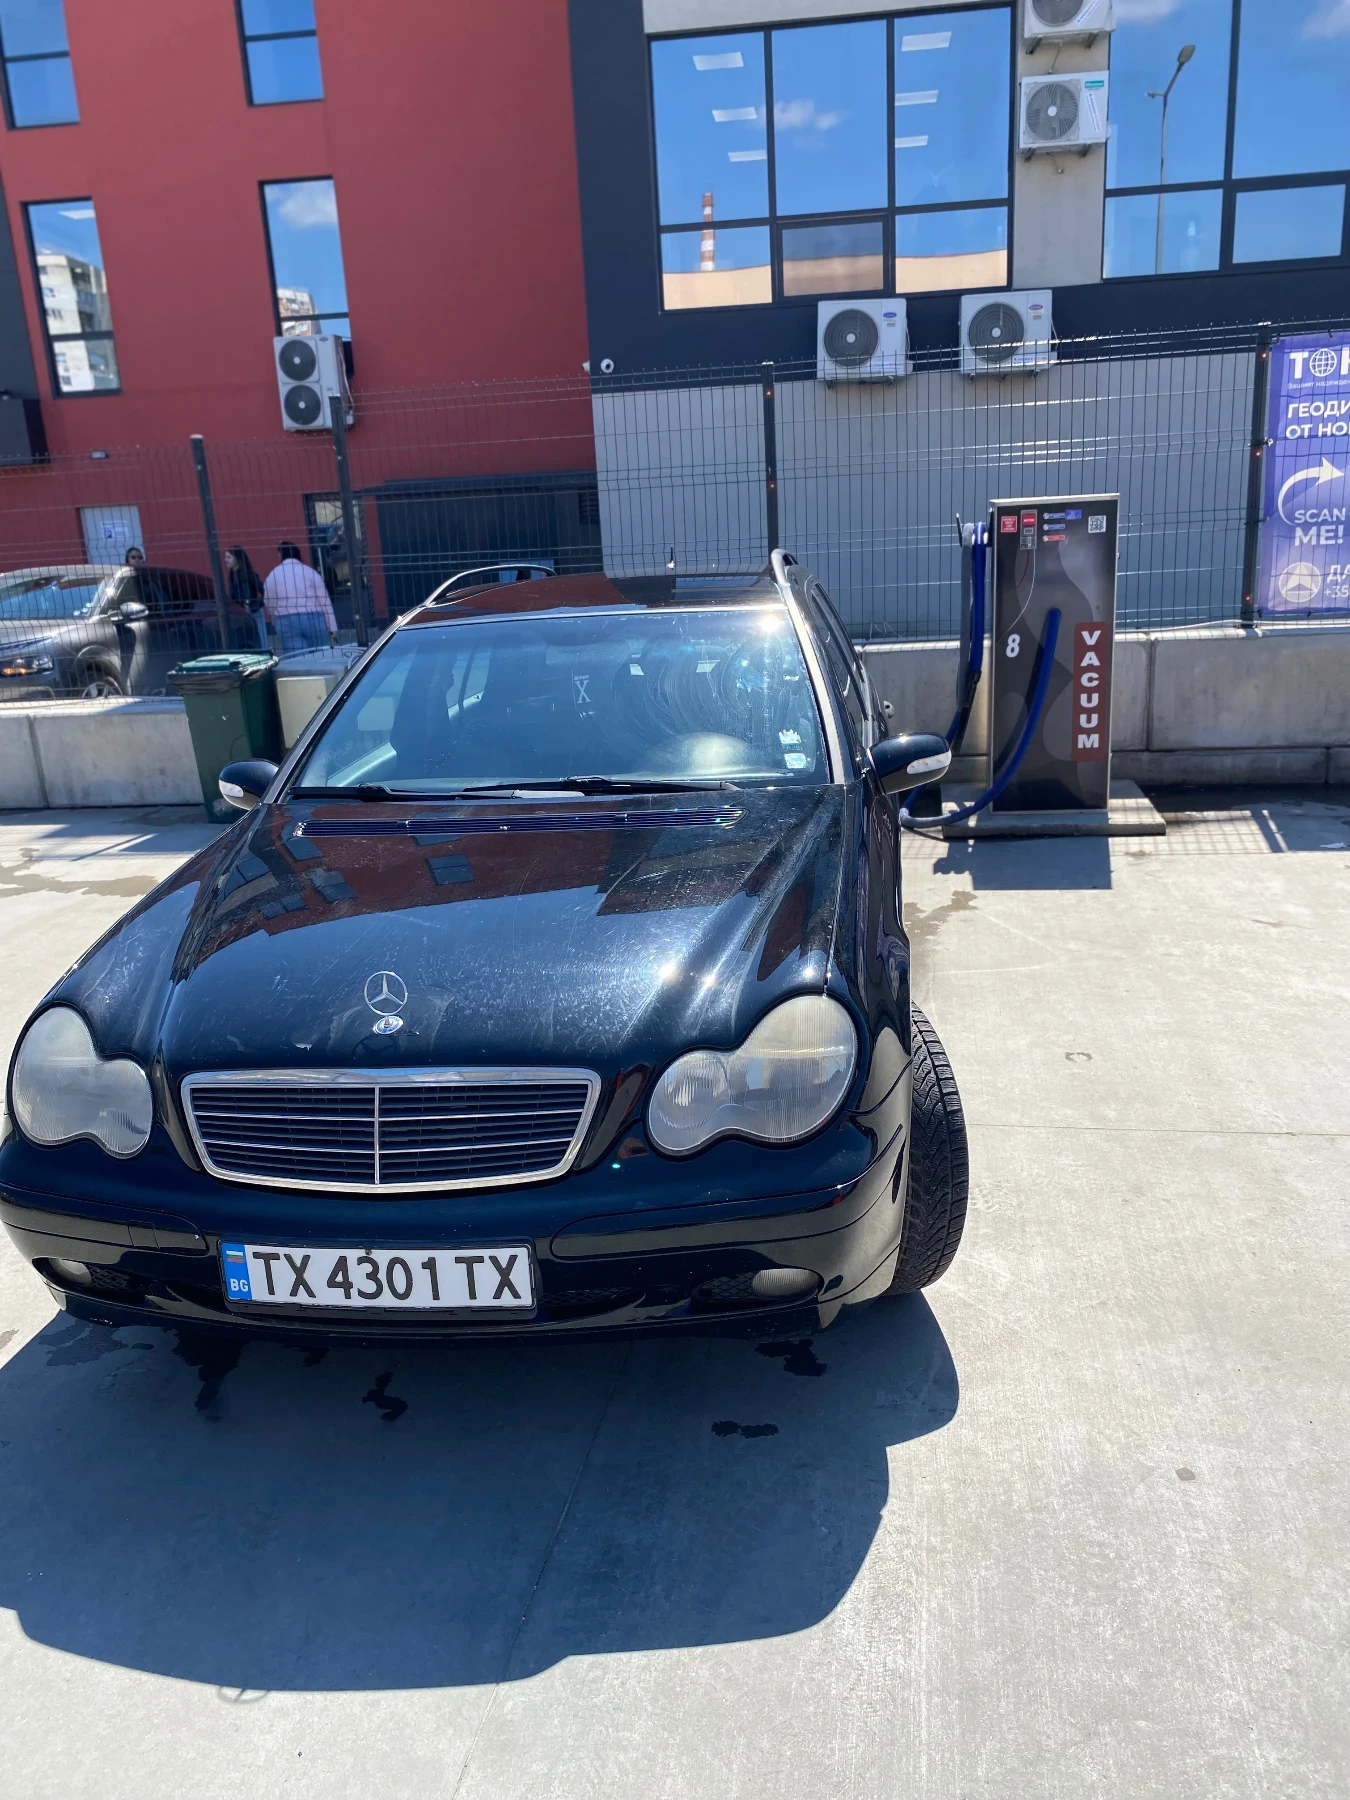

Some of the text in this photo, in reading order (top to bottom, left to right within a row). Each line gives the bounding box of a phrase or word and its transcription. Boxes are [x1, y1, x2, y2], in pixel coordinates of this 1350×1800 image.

[1285, 421, 1350, 440] ОТ НО
[1294, 507, 1346, 524] SCAN
[1294, 524, 1344, 547] ME!
[1005, 633, 1021, 658] 8
[574, 679, 592, 704] X
[1077, 630, 1102, 749] VACUUM
[229, 1251, 522, 1301] BG TX 4301 TX
